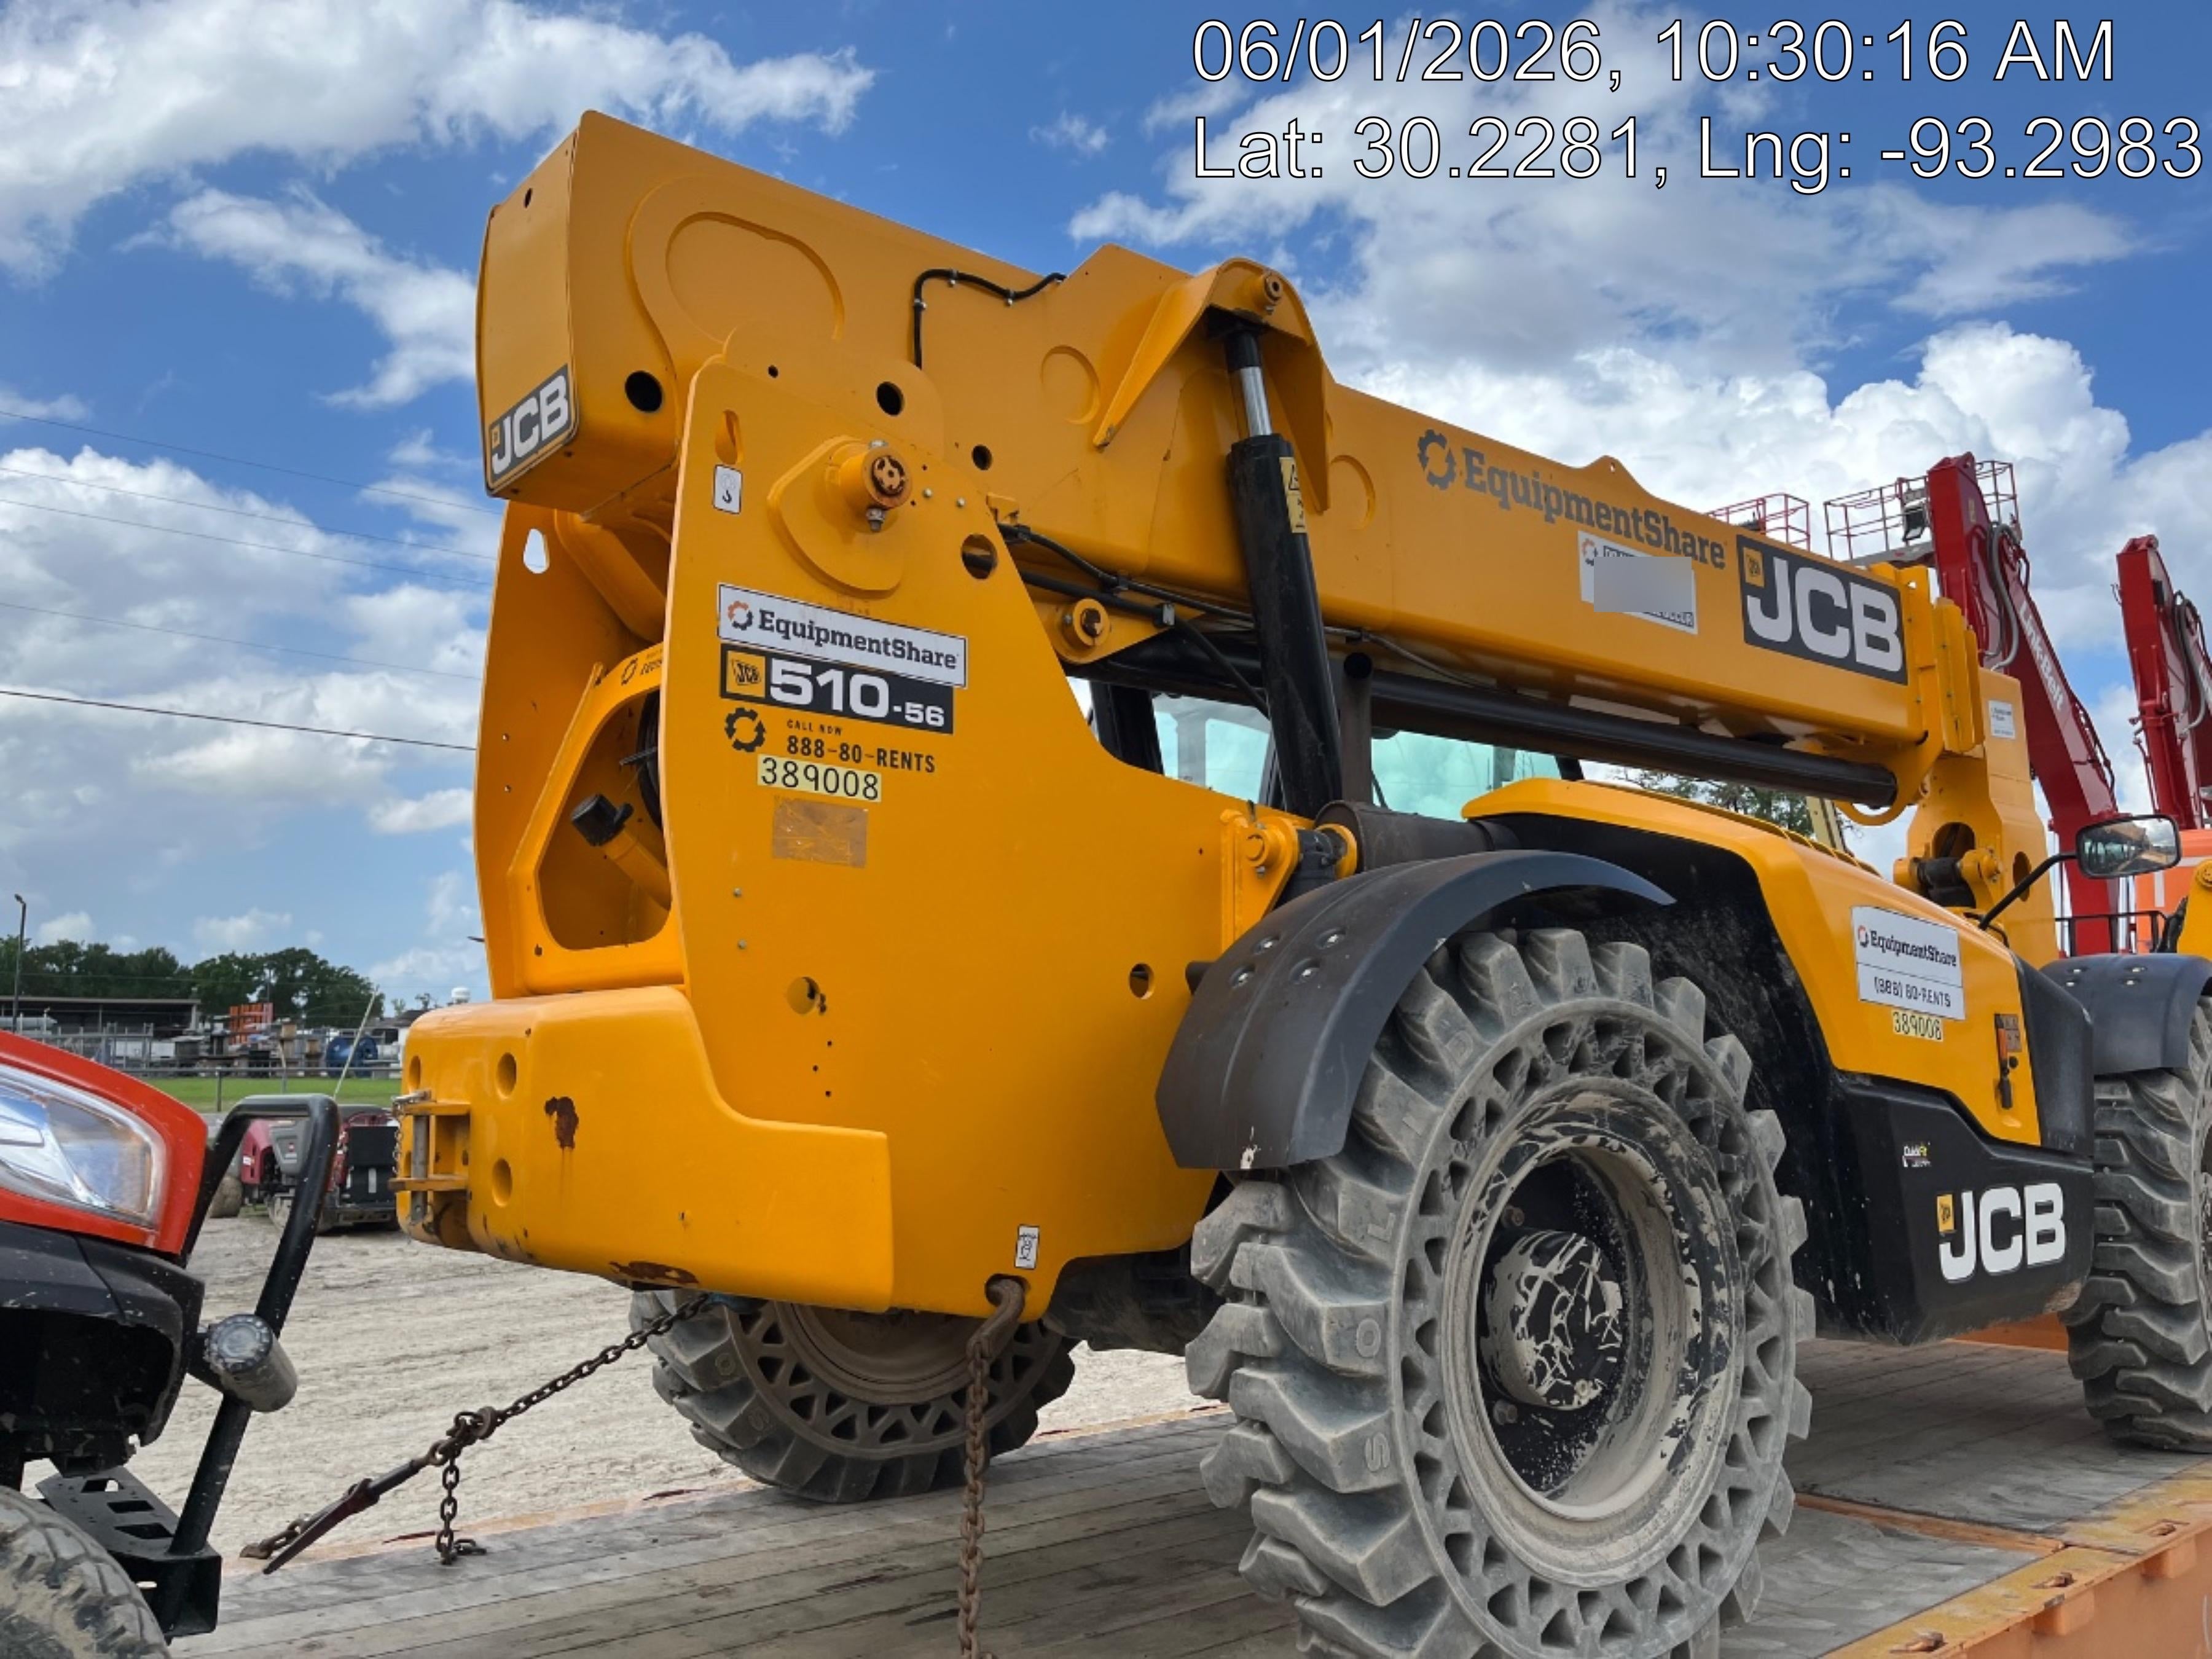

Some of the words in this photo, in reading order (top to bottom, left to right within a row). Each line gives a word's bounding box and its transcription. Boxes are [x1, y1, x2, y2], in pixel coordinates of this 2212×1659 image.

[492, 375, 568, 475] JCB
[1463, 447, 1725, 570] EquipmentShare
[758, 608, 957, 670] EquipmentShare
[1747, 557, 1903, 673] JCB
[786, 735, 936, 774] 888-80-RENTS
[787, 719, 814, 732] CALL
[819, 724, 843, 737] NOW
[761, 757, 879, 801] 389008
[1870, 930, 1957, 967] EquipmentShare
[1939, 1183, 2066, 1281] JCB
